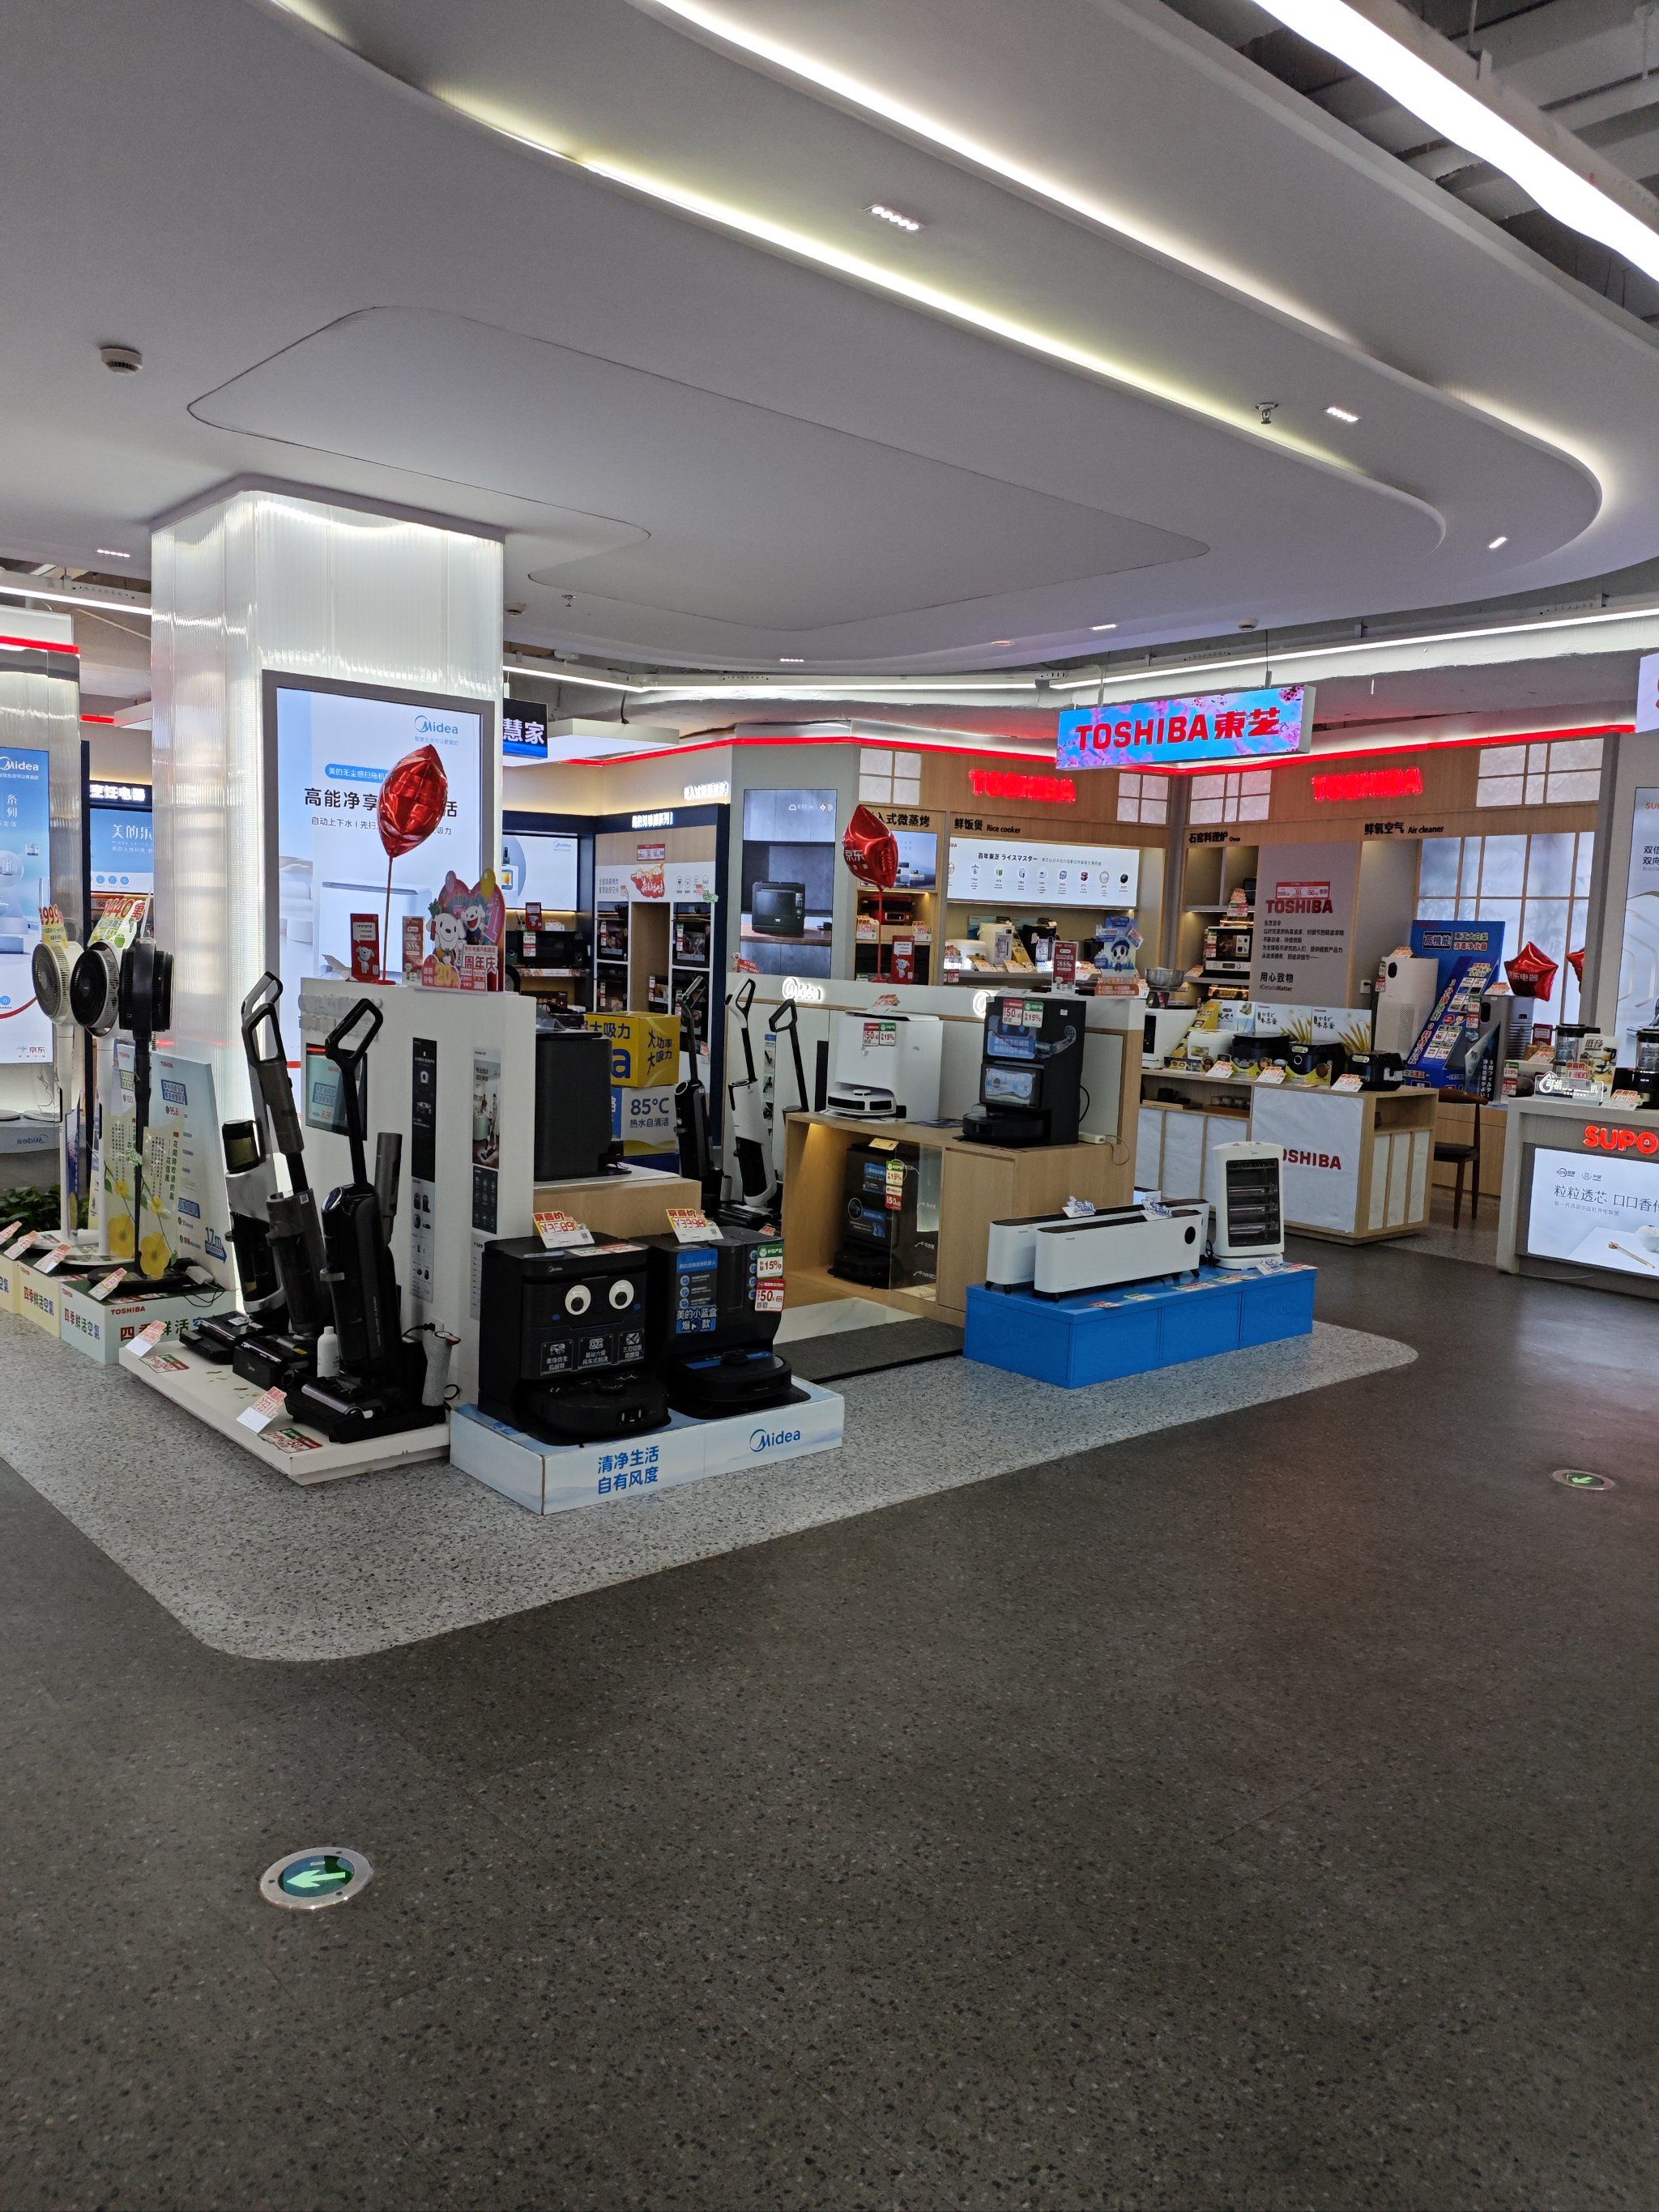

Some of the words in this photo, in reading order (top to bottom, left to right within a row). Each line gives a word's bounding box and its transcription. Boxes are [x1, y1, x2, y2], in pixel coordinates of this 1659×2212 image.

[415, 715, 458, 735] Midea
[503, 718, 545, 745] 慧家
[1075, 713, 1209, 750] TOSHIBA
[1214, 707, 1281, 739] 東芝
[0, 757, 39, 771] Midea
[969, 769, 1077, 803] TOSHIBA
[1312, 767, 1423, 803] TOSHIBA
[304, 787, 378, 812] 高能净享
[875, 812, 931, 828] 入式微蒸烤
[954, 818, 983, 833] 鲜饭煲
[987, 824, 1000, 833] Rice
[1000, 825, 1021, 834] cooker
[1408, 825, 1418, 834] Air
[1418, 825, 1444, 834] cleaner
[844, 850, 866, 862] 京东
[1265, 899, 1333, 914] TOSHIBA
[1423, 934, 1452, 947] 高機能
[465, 955, 497, 972] 周年庆
[1260, 971, 1294, 983] 用心致物
[1006, 1008, 1016, 1017] 50
[1028, 1013, 1042, 1022] 15%
[583, 1021, 631, 1040] 大吸力
[866, 1031, 874, 1039] 50
[647, 1029, 672, 1049] 大功率
[647, 1049, 672, 1076] 大吸力
[629, 1117, 669, 1128] 热水自清洁
[1583, 1125, 1659, 1155] SUPO
[1554, 1183, 1608, 1204] 粒粒透芯
[765, 1260, 782, 1271] 15%
[761, 1290, 774, 1302] 50
[110, 1306, 146, 1315] TOSHIBA
[676, 1307, 718, 1320] 美的小蓝盒
[749, 1428, 801, 1453] Midea
[598, 1445, 659, 1474] 清净生活
[598, 1465, 659, 1495] 自有风度
